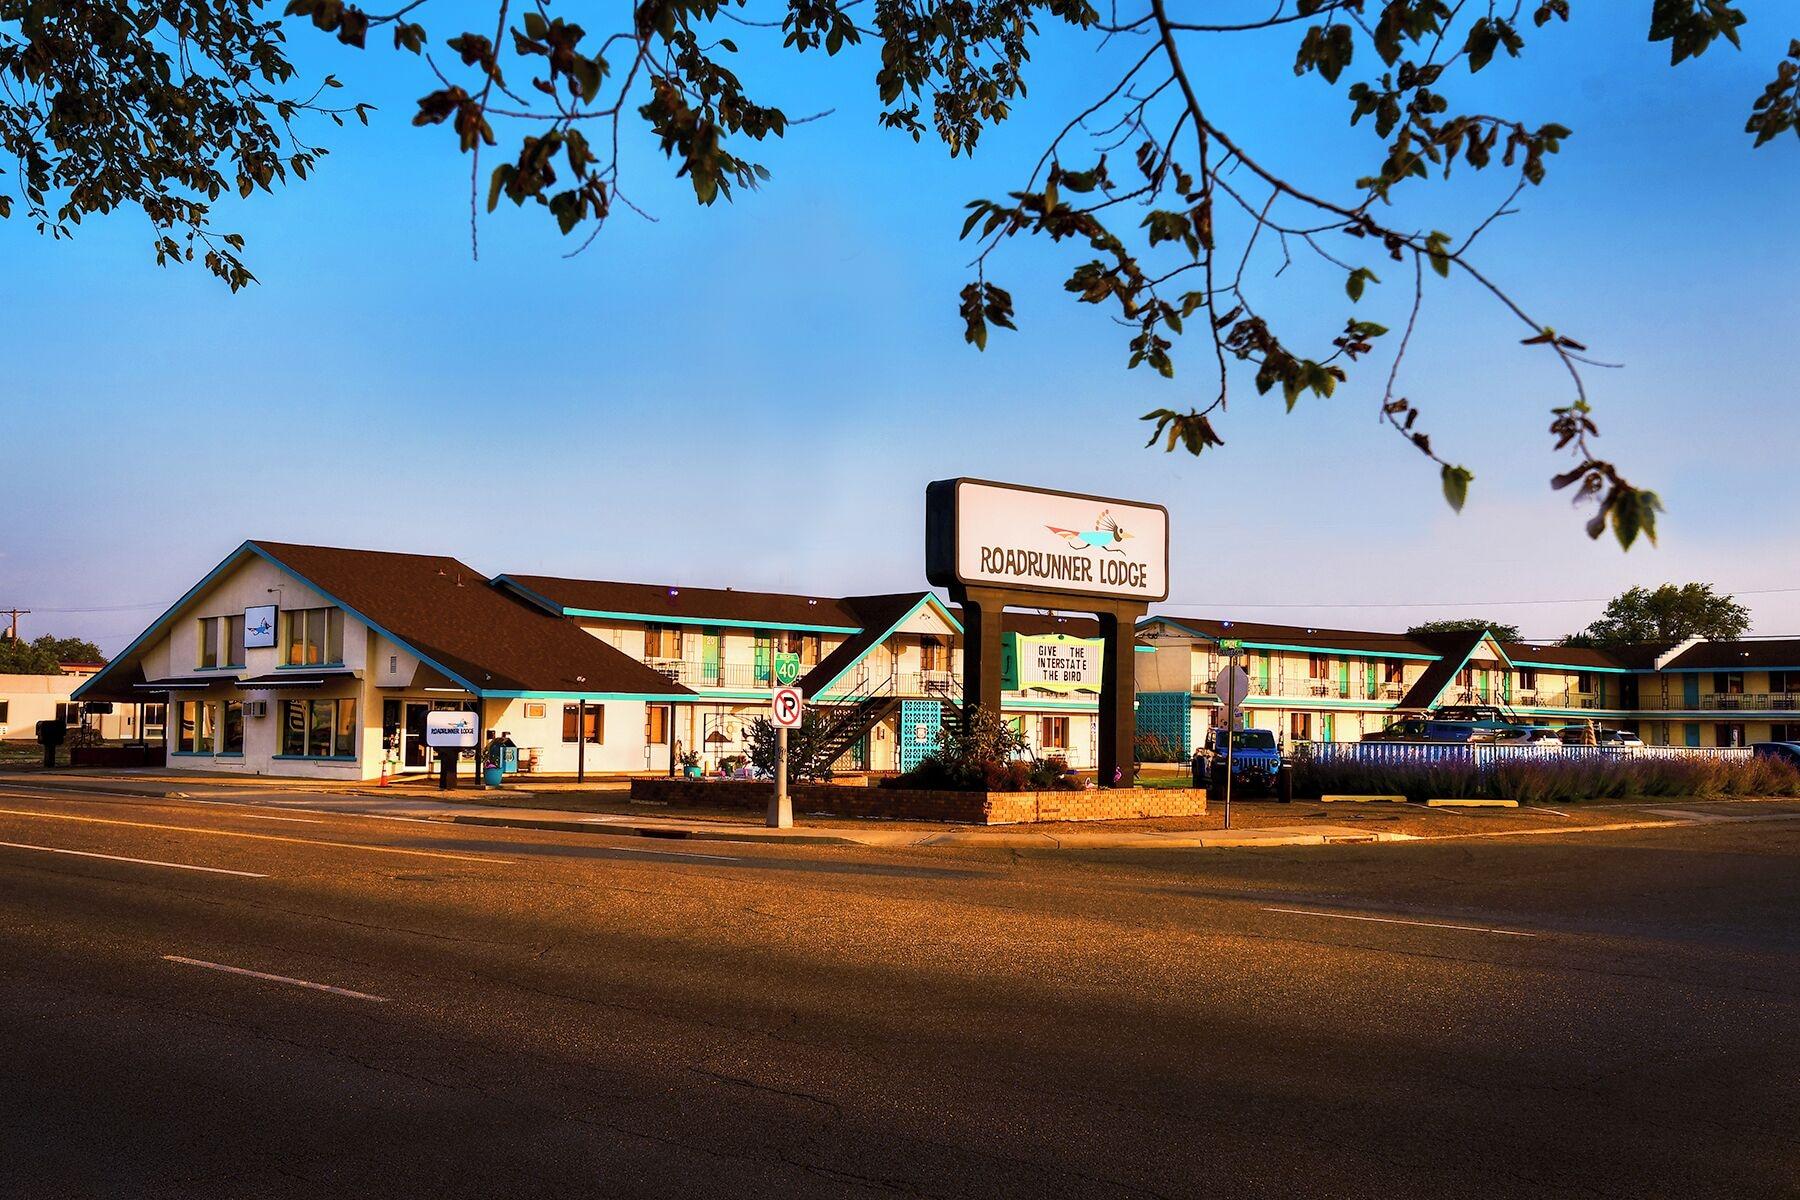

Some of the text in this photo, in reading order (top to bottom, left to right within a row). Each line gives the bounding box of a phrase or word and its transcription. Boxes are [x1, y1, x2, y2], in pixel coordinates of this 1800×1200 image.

[981, 547, 1147, 588] ROADRUNNER LODGE
[1039, 646, 1084, 657] GIVE THE
[1038, 658, 1086, 670] INTERSTATE
[779, 664, 795, 678] 40
[1043, 670, 1081, 681] THE BIRD
[783, 697, 795, 717] P
